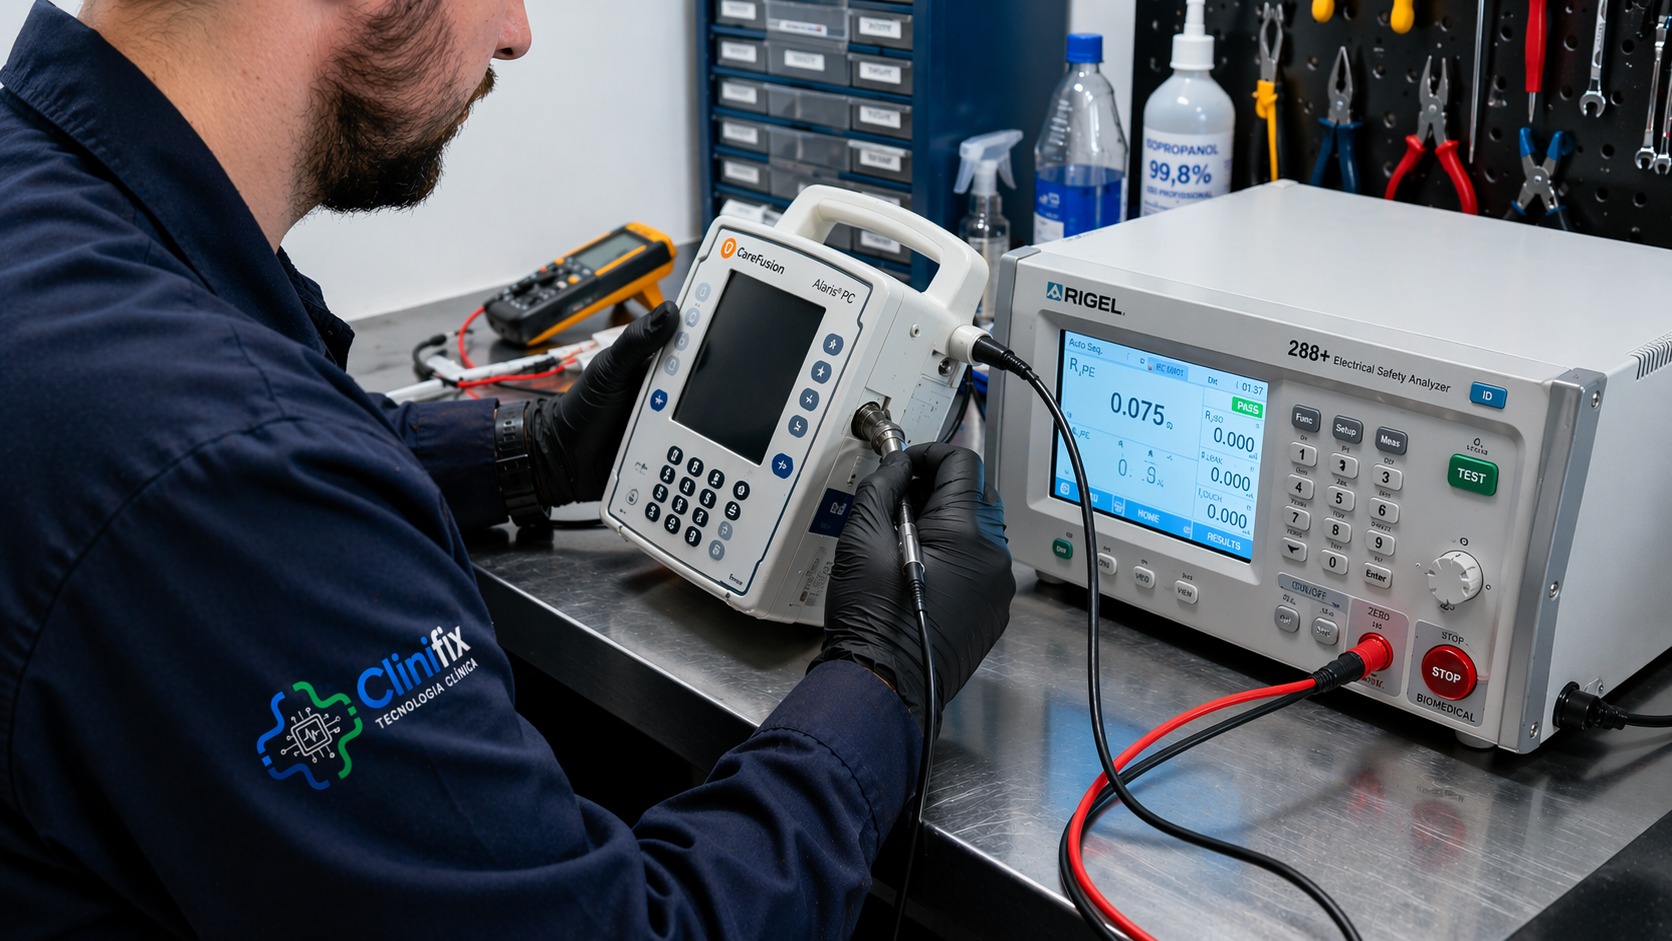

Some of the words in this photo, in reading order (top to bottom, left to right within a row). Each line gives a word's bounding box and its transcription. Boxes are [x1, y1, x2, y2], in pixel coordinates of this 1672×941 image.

[1149, 160, 1212, 187] 99,8%
[736, 246, 785, 275] CareFusion
[841, 290, 856, 304] PC
[1064, 286, 1122, 315] RIGEL
[1287, 339, 1330, 363] 288+
[1333, 355, 1375, 374] Electrical
[1377, 366, 1406, 384] Safety
[1408, 374, 1451, 393] Analyzer
[1482, 389, 1493, 401] ID
[1110, 391, 1165, 426] 0.075
[1237, 401, 1259, 415] PASS
[1295, 412, 1313, 425] Func
[1335, 423, 1357, 438] Setup
[1213, 427, 1255, 453] 0.000
[1380, 434, 1401, 448] Meas
[1299, 448, 1305, 460] 1
[1211, 466, 1251, 492] 0.000
[1381, 471, 1390, 483] 3
[1457, 467, 1486, 484] TEST
[1295, 481, 1302, 493] 4
[1335, 492, 1343, 504] 5
[1137, 509, 1160, 524] HOME
[1207, 503, 1247, 529] 0.000
[1378, 504, 1386, 516] 6
[1292, 512, 1299, 523] 7
[1332, 524, 1339, 536] 8
[1207, 532, 1241, 551] RESULTS
[1375, 537, 1383, 549] 9
[1329, 556, 1336, 568] 0
[1366, 569, 1387, 582] Enter
[1441, 631, 1464, 645] STOP
[356, 625, 471, 709] Clinifix
[1432, 665, 1461, 684] STOP
[375, 682, 445, 729] TECNOLOGIA
[444, 657, 478, 688] CLÍNICA
[1416, 693, 1475, 723] BIOMEDICAL
